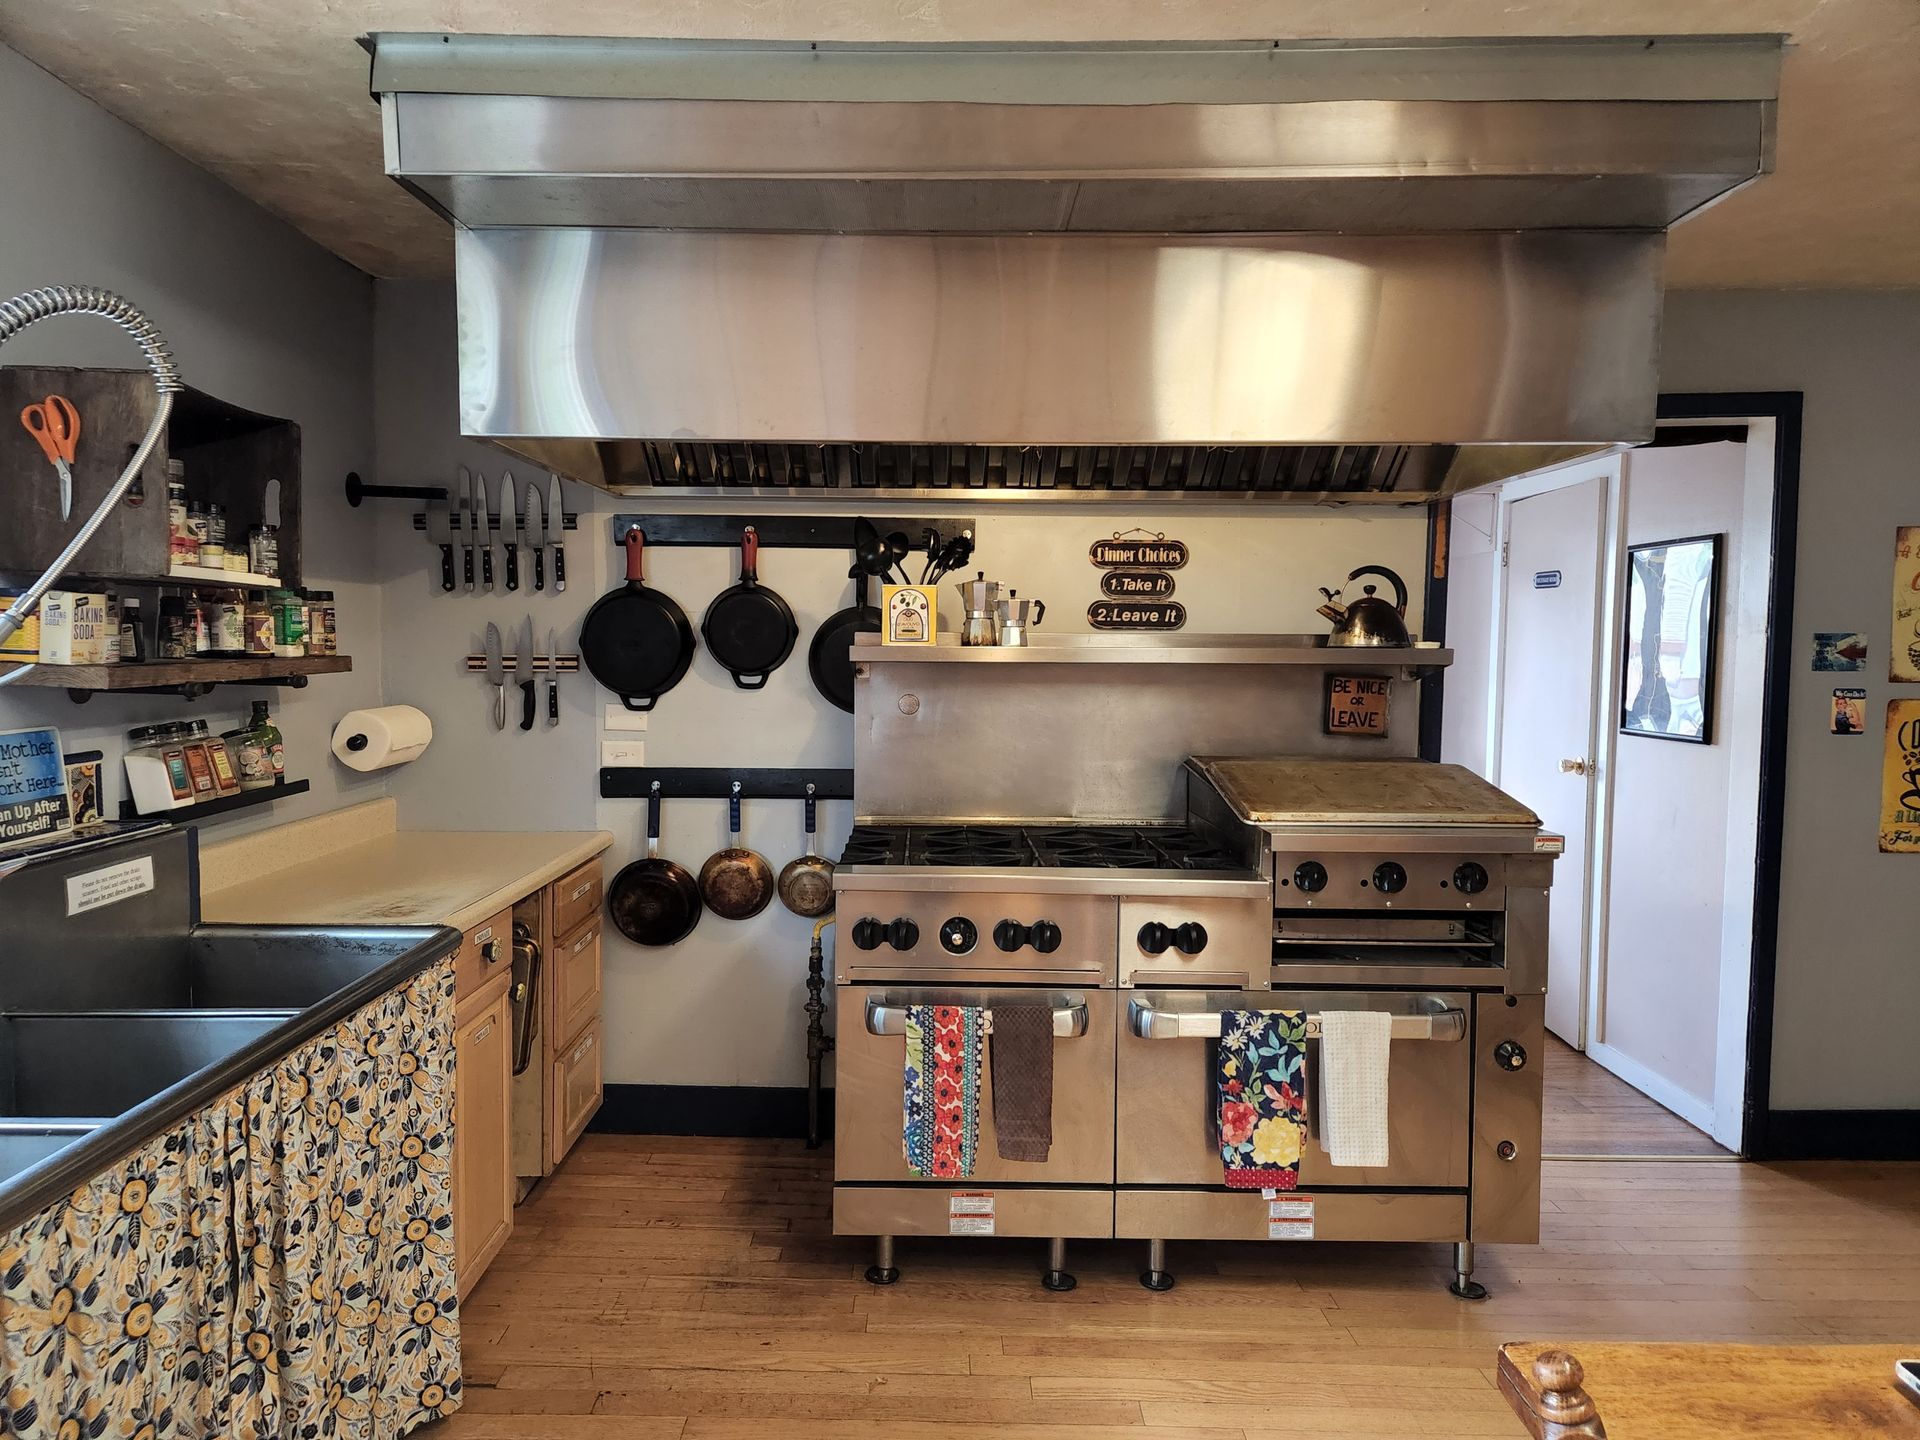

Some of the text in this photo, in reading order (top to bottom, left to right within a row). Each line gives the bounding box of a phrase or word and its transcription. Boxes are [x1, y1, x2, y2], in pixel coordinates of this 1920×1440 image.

[1097, 547, 1180, 562] Dinner Choices
[1156, 579, 1166, 591] It
[45, 610, 67, 619] BAKING
[74, 607, 103, 623] BAKING
[1165, 609, 1177, 622] It
[74, 624, 95, 640] SODA
[1333, 679, 1385, 695] BE NICE
[1350, 697, 1365, 706] OR
[1332, 707, 1379, 728] LEAVE
[0, 740, 54, 760] Mother
[0, 780, 23, 796] ork
[15, 804, 31, 820] Up
[34, 800, 61, 816] After
[0, 815, 51, 837] Yourself!
